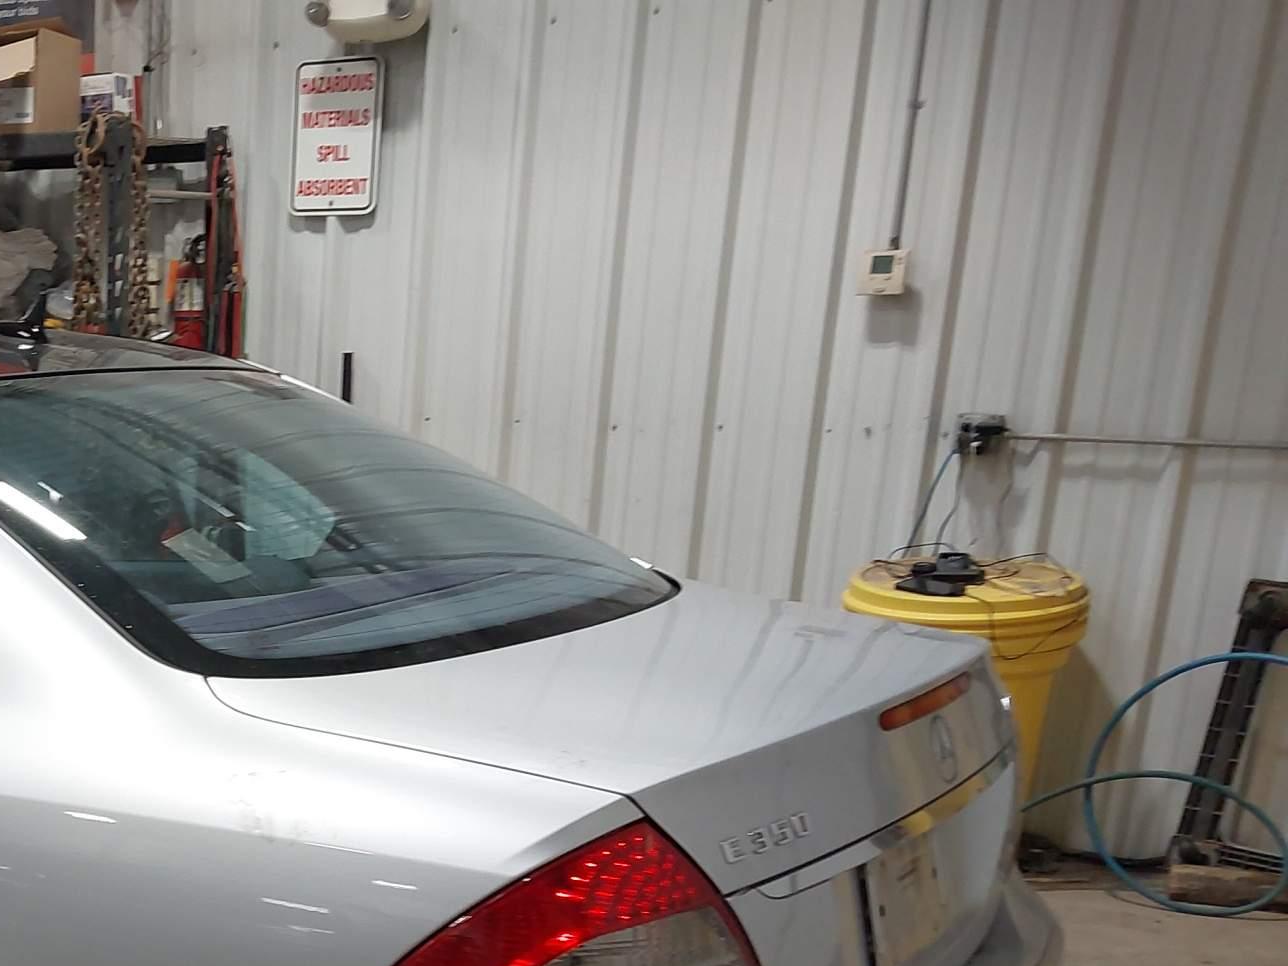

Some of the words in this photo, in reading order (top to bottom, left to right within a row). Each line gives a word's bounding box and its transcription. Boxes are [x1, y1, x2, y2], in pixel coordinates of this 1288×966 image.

[300, 73, 376, 95] HAZARDOUS
[301, 108, 372, 129] MATERIALS
[316, 145, 350, 162] SPILL
[296, 178, 369, 197] ABSORBENT
[719, 838, 747, 864] E
